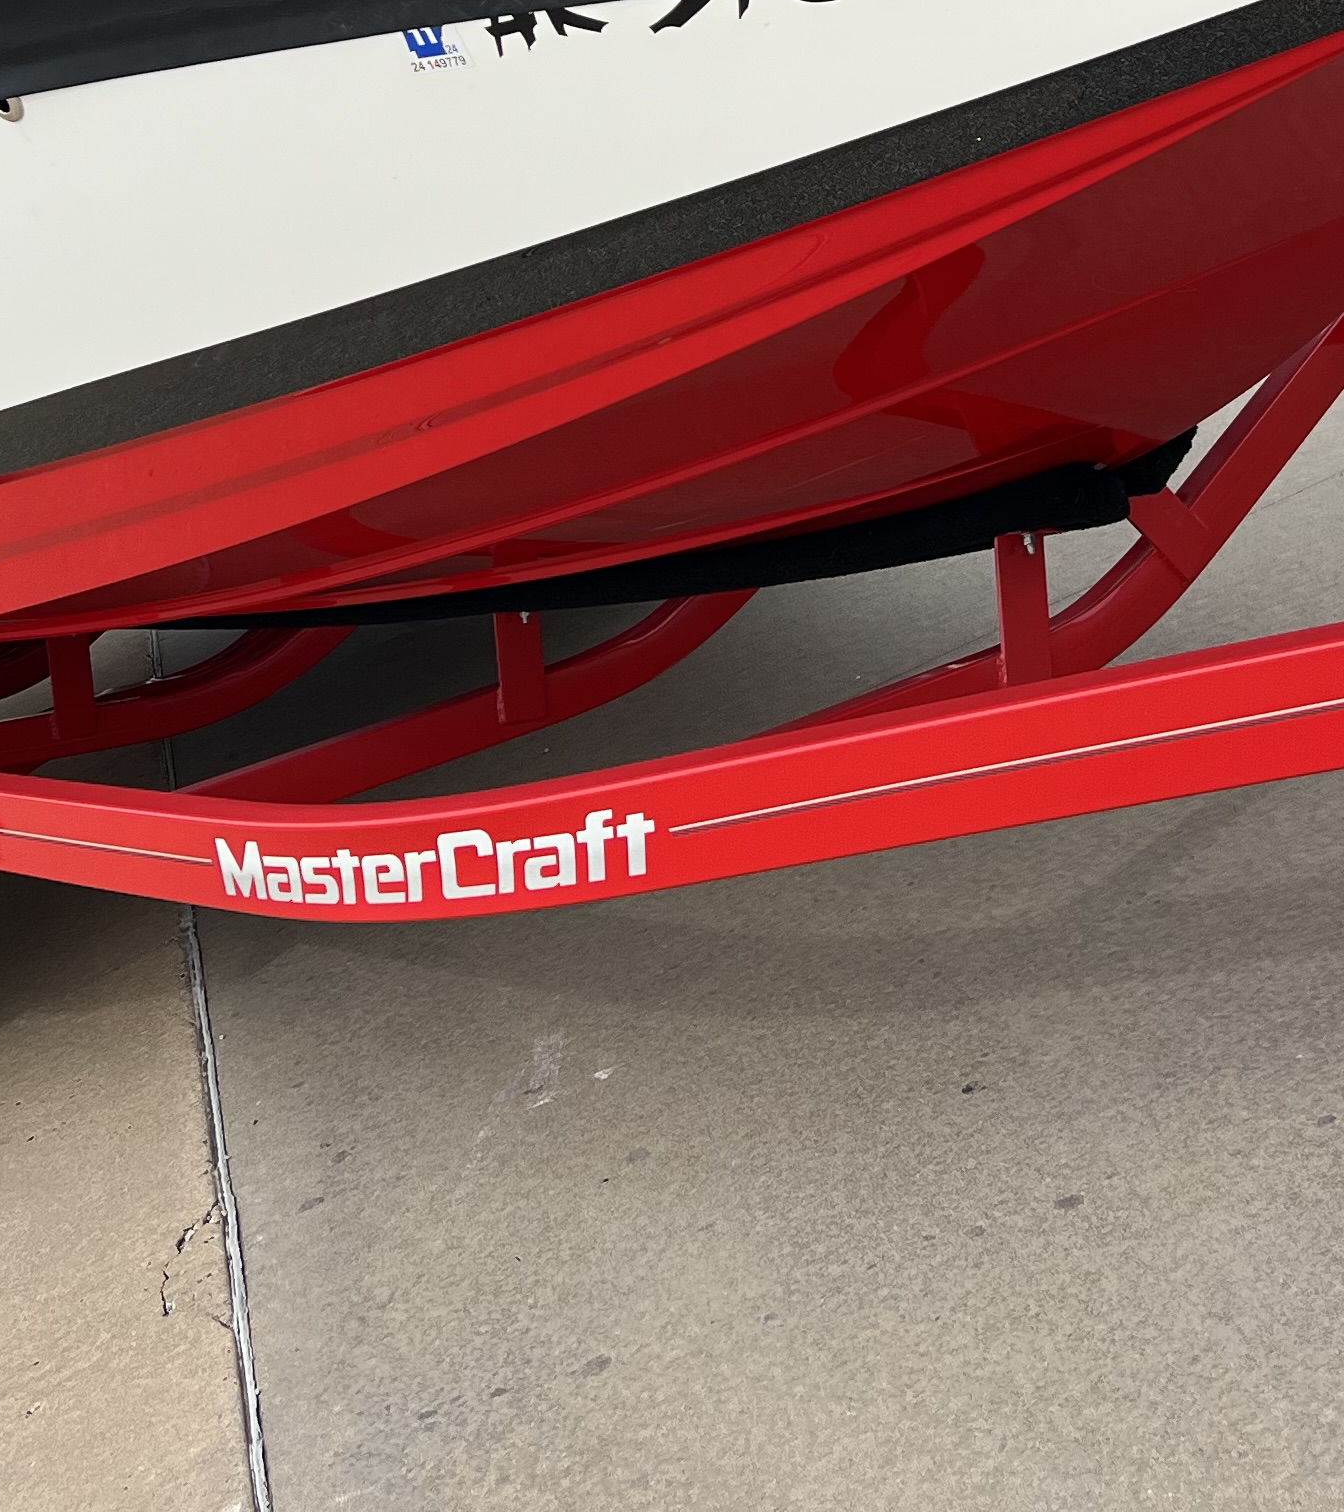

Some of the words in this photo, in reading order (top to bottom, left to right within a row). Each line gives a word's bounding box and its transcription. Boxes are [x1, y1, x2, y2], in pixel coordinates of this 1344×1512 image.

[445, 44, 458, 54] 24
[411, 62, 426, 72] 24
[428, 55, 467, 69] 149779
[214, 808, 656, 906] MasterCraft
